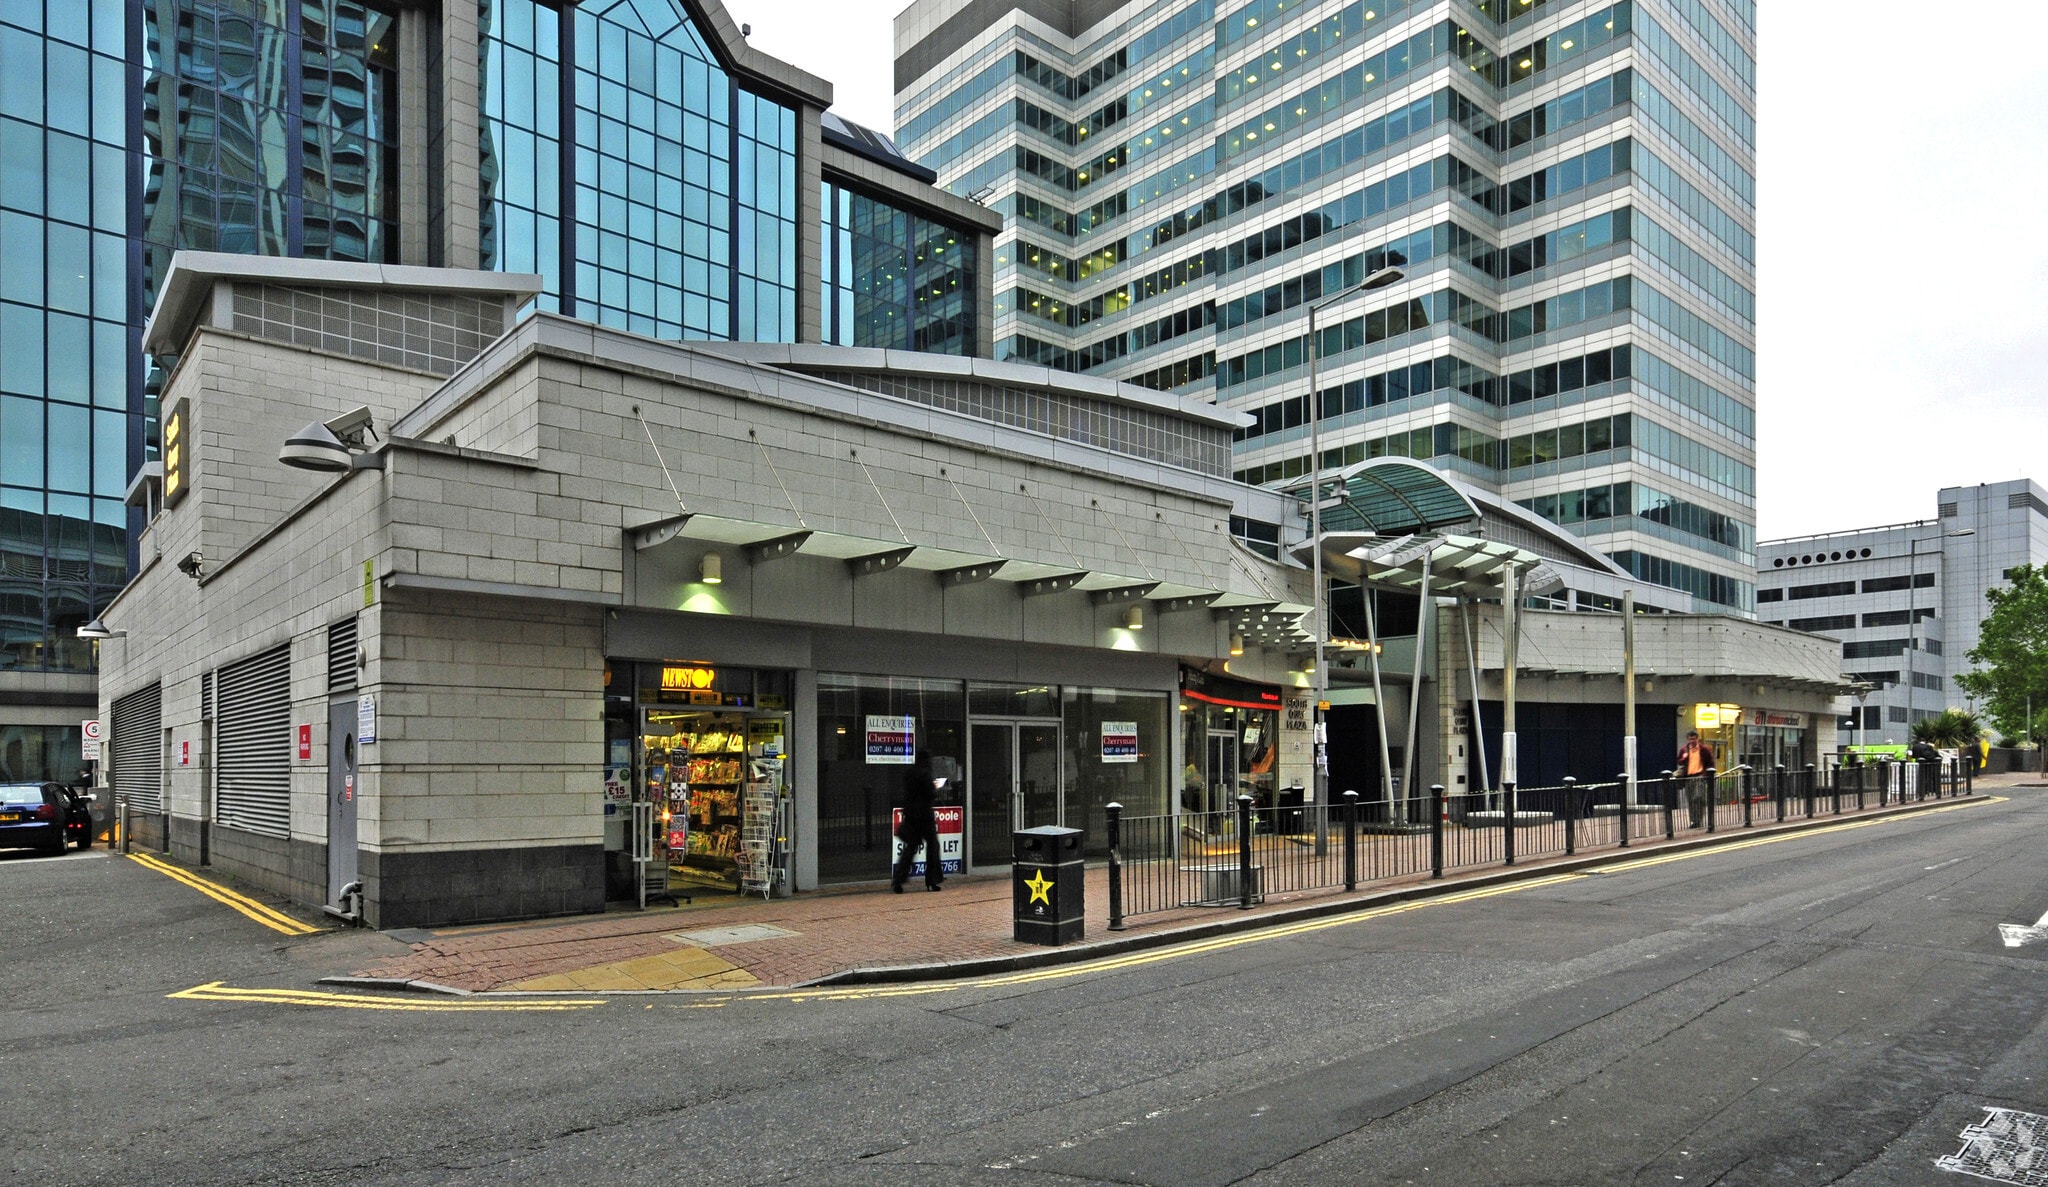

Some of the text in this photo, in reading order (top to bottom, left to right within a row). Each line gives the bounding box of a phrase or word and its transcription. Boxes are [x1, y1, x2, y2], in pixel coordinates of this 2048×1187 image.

[661, 667, 715, 689] NEWSTOP
[868, 718, 880, 728] ALL
[868, 733, 912, 744] Cherryman
[608, 786, 626, 796] £15
[934, 810, 959, 821] Poole
[896, 840, 959, 857] SP LET
